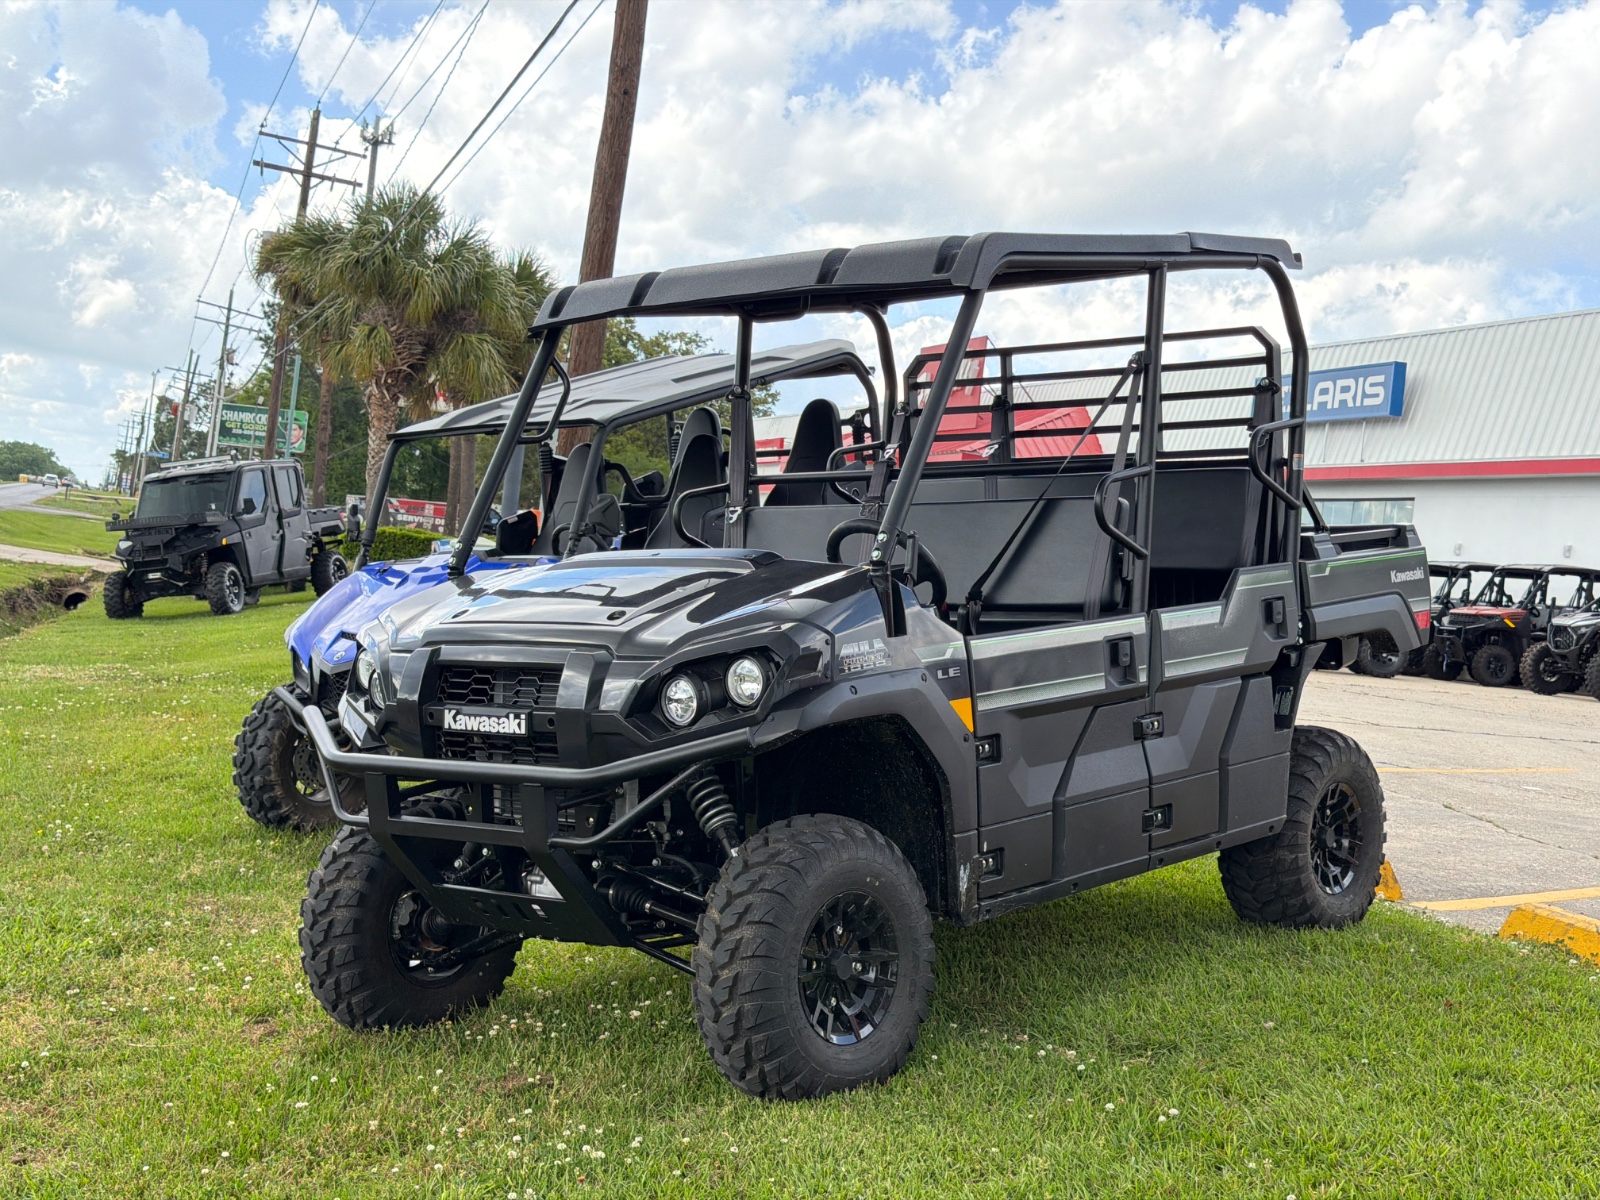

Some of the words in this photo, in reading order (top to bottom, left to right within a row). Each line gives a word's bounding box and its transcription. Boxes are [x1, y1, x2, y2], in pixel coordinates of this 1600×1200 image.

[1281, 375, 1385, 412] ARIS
[1390, 566, 1425, 583] Kawasaki
[937, 666, 961, 680] LE
[444, 709, 526, 734] Kawasaki
